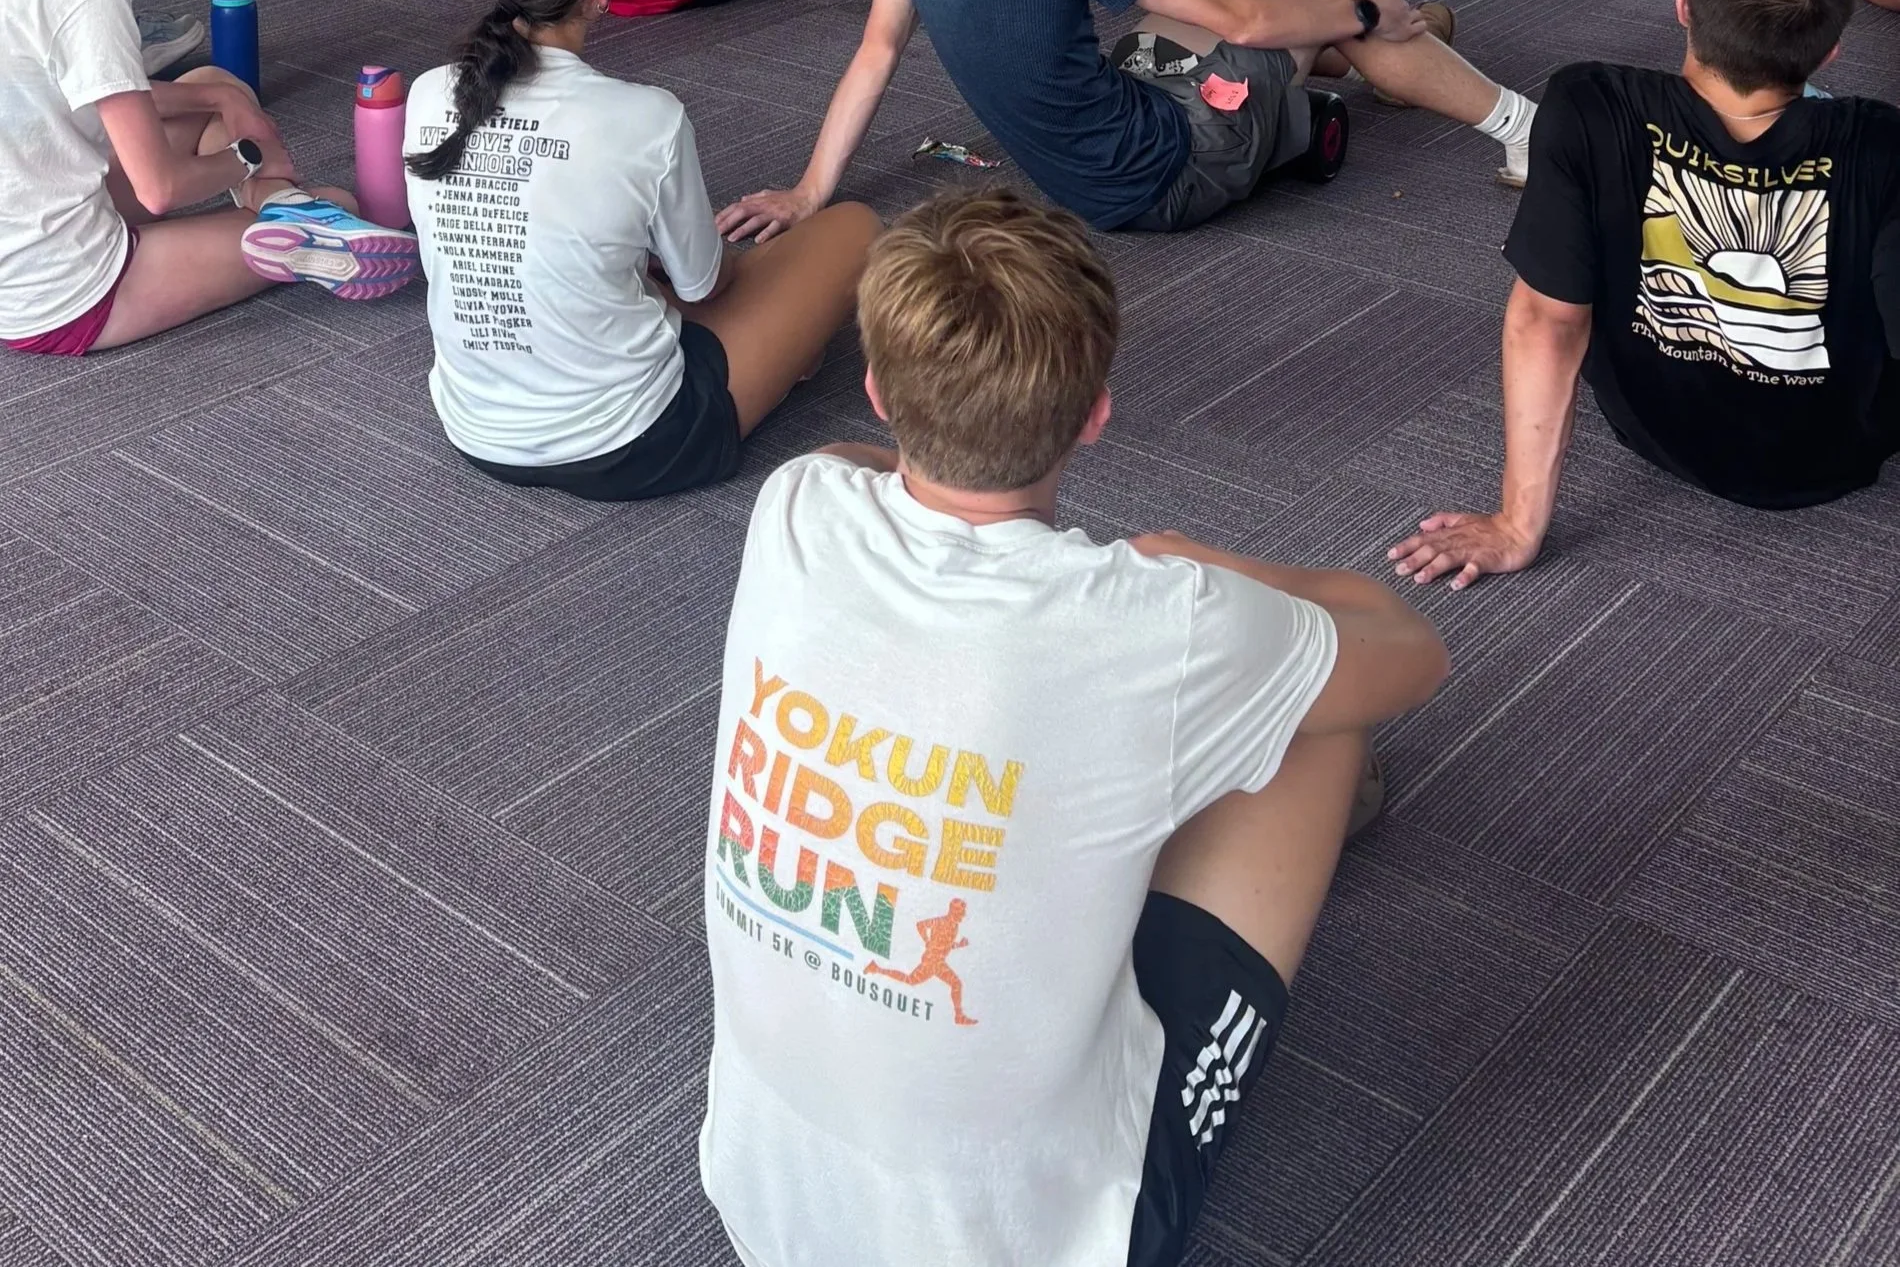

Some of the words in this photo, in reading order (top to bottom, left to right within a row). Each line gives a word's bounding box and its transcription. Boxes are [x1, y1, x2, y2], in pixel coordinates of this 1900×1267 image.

[500, 117, 540, 131] FIELD
[466, 131, 514, 153] OVE
[519, 136, 570, 160] OUR
[1646, 123, 1833, 187] QUIKSILVER
[458, 151, 533, 177] NIORS
[446, 175, 472, 188] KARA
[475, 178, 519, 192] BRACCIO
[443, 190, 473, 202] JENNA
[476, 193, 520, 207] BRACCIO
[435, 203, 479, 217] GABRIELA
[436, 217, 460, 229] PAIGE
[463, 220, 493, 232] DELLA
[497, 223, 527, 236] BITTA
[438, 232, 478, 244] SHAWNA
[481, 235, 526, 250] FERRARO
[443, 246, 466, 257] NOLA
[468, 247, 523, 263] KAMMERER
[452, 260, 478, 272] ARIEL
[480, 263, 516, 275] LEVINE
[450, 273, 475, 284] SOFIA
[454, 299, 484, 311] OLIVIA
[454, 312, 490, 324] NATALIE
[462, 339, 489, 350] EMILY
[1658, 340, 1728, 368] Mountain
[1746, 370, 1780, 385] The
[1782, 374, 1825, 386] Wave
[749, 655, 1025, 819] YOKUN
[728, 717, 1006, 892] RIDGE
[716, 787, 900, 960] RUN
[772, 932, 794, 959] 5K
[804, 950, 822, 971] @
[831, 961, 934, 1021] BOUSQUET
